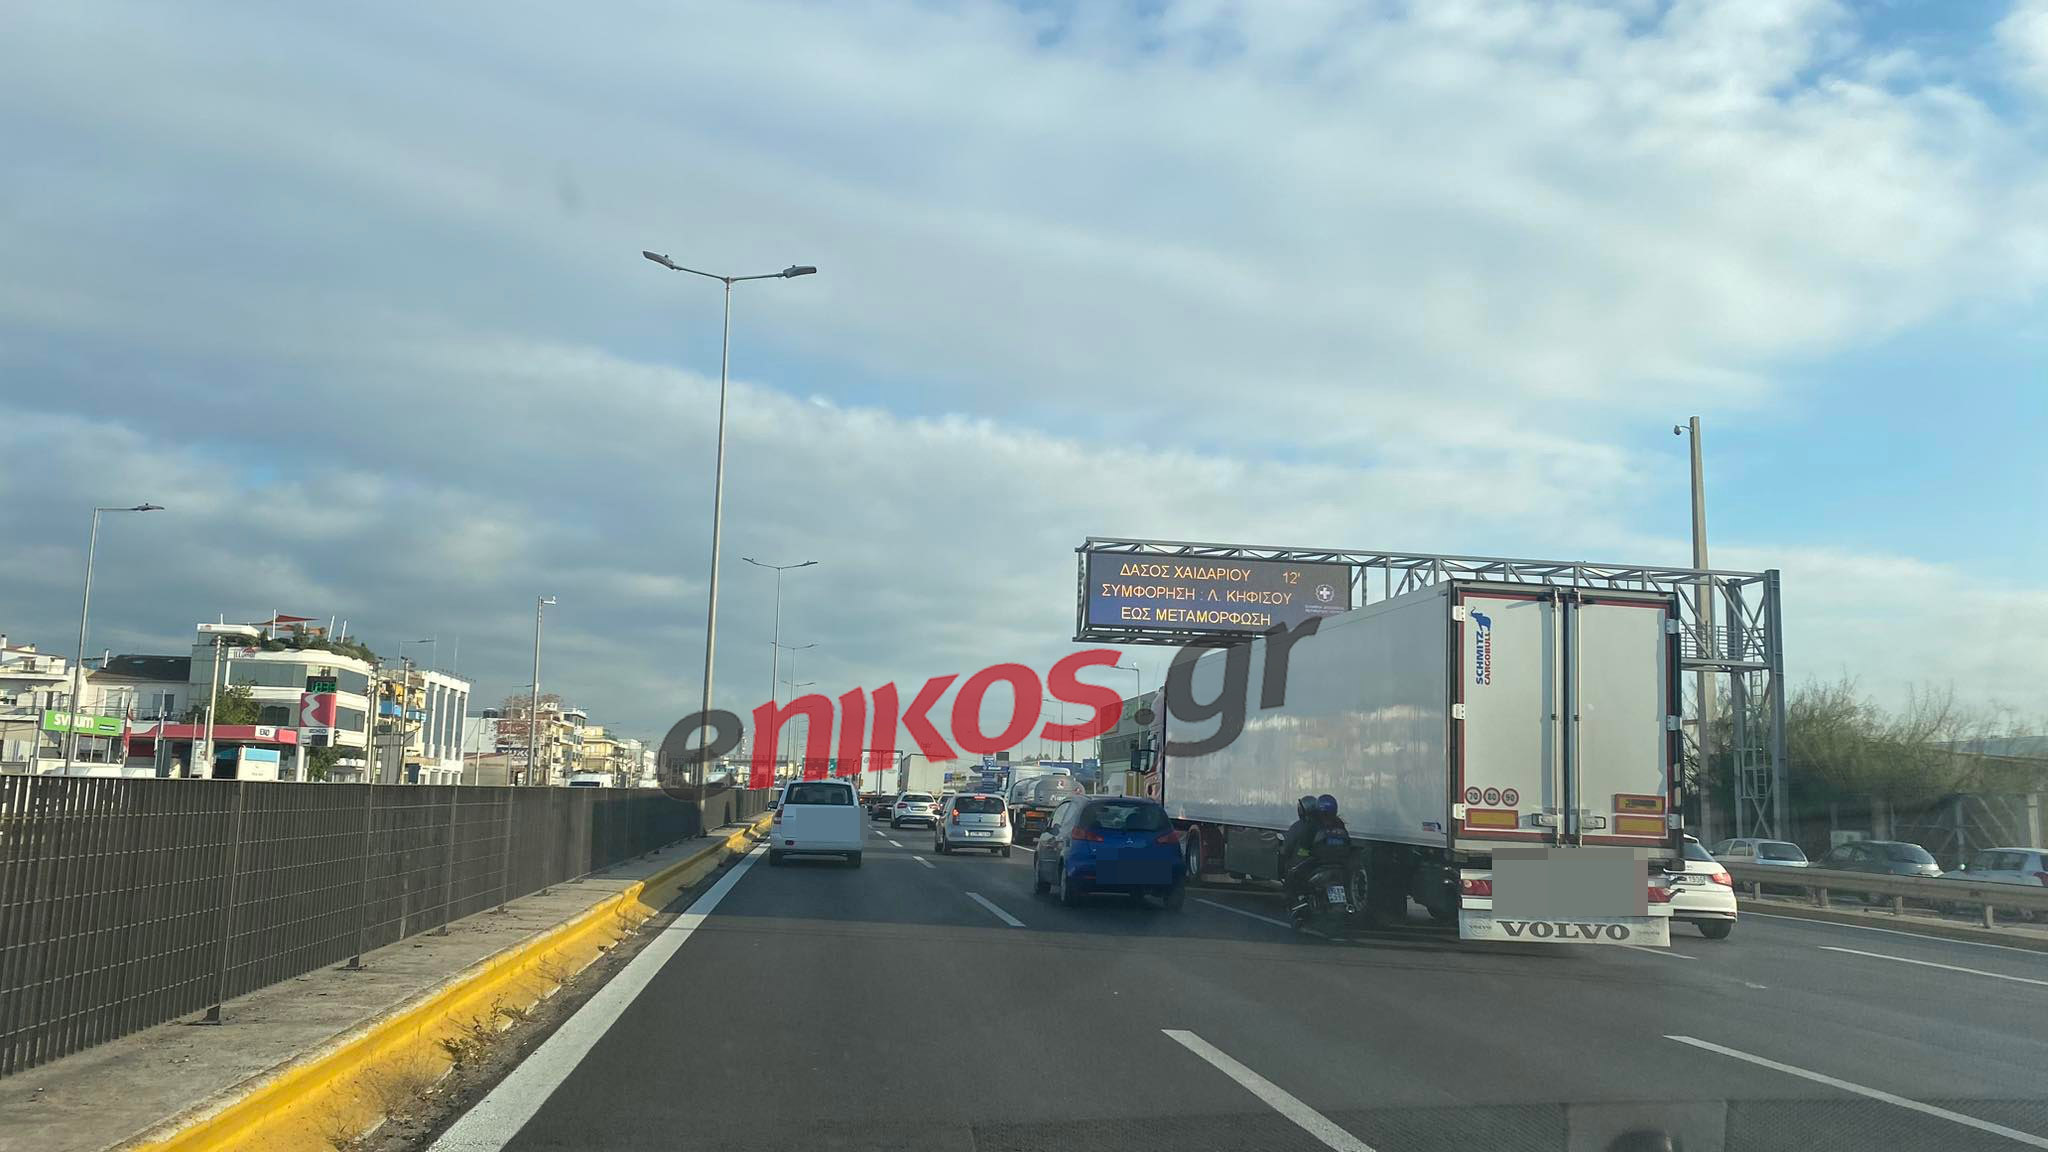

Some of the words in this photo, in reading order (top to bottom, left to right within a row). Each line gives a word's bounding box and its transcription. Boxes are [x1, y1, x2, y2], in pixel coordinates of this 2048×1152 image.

[1119, 563, 1170, 578] ΔΑΣΟΣ
[1174, 565, 1251, 582] ΧΑΙΔΑΡΙΟΥ
[1101, 583, 1195, 601] ΣΥΜΦΟΡΗΣΗ
[1226, 590, 1292, 605] ΚΗΦΙΣΟΥ
[1121, 607, 1151, 621] ΕΩΣ
[1155, 608, 1271, 626] ΜΕΤΑΜΟΡΦΩΣΗ
[1476, 631, 1484, 685] SCHMITZ
[1469, 791, 1479, 800] 70
[1487, 792, 1497, 801] 80
[1496, 920, 1630, 940] VOLVO
